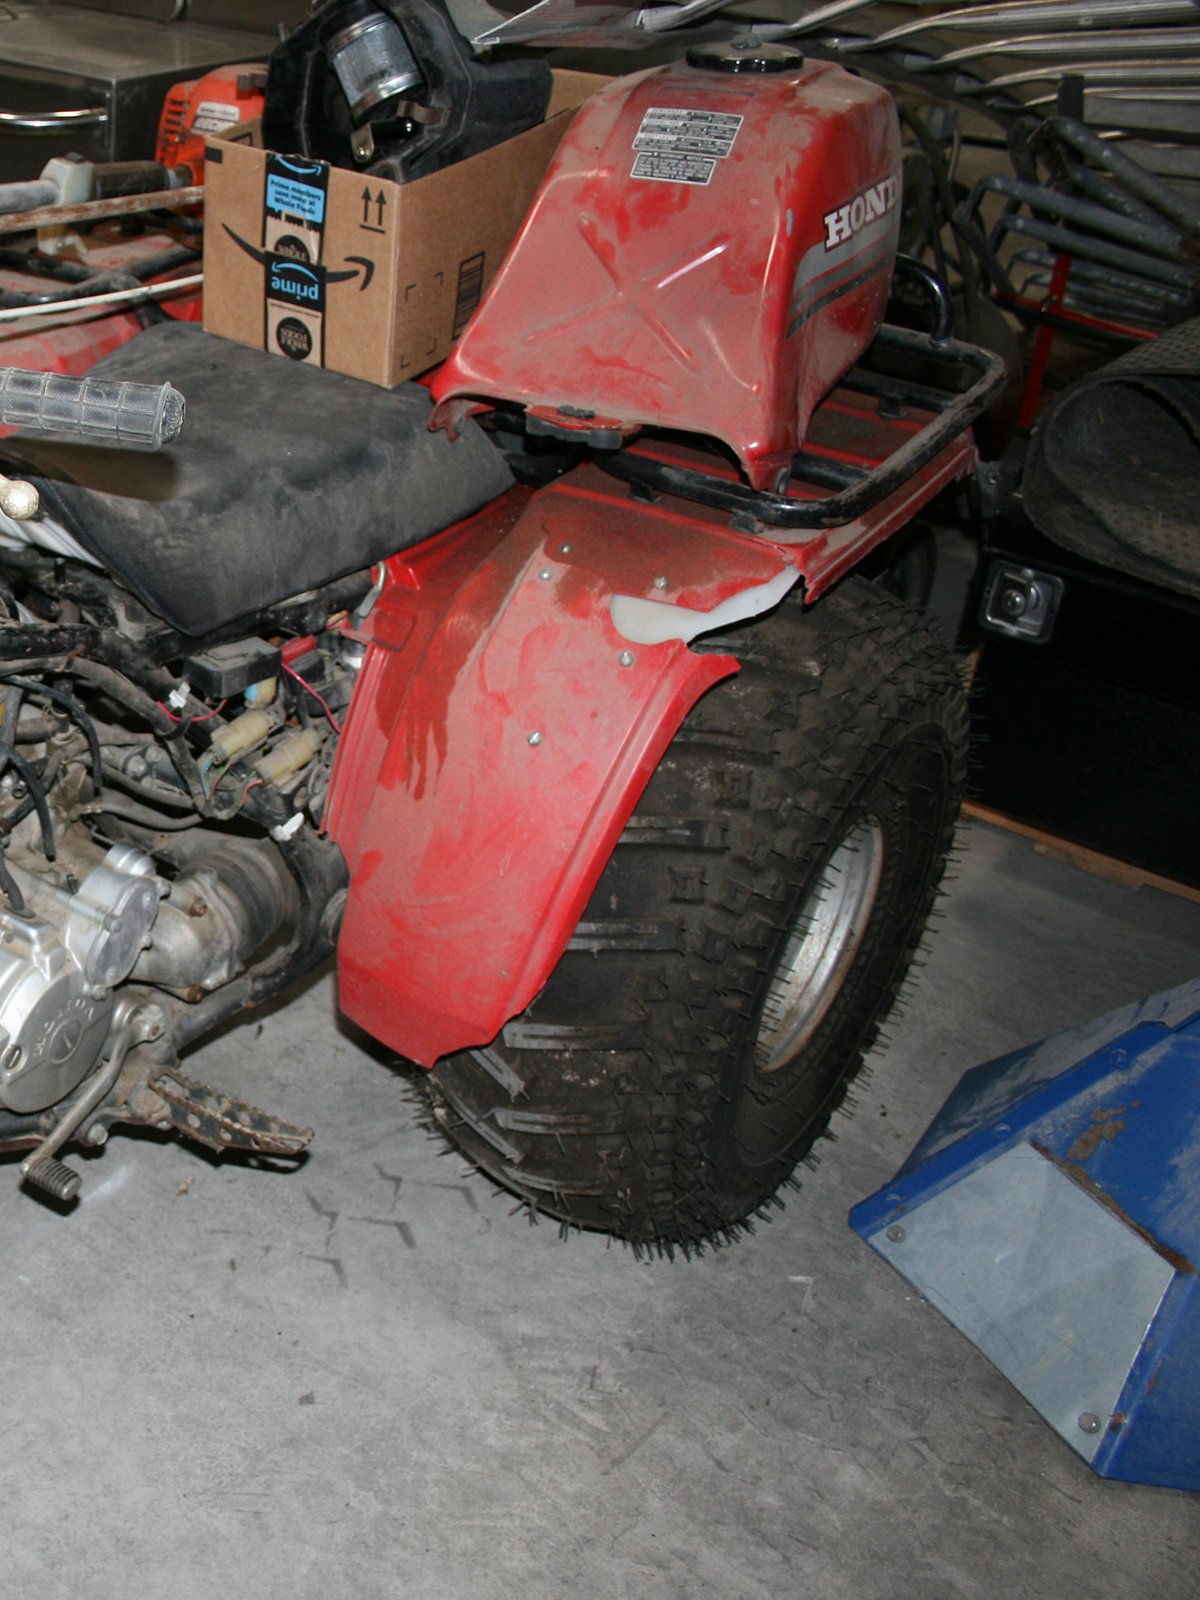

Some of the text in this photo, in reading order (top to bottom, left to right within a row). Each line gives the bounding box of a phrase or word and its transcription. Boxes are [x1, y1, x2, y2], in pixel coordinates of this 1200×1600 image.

[270, 178, 290, 191] Prime
[274, 196, 295, 208] Whole
[824, 174, 898, 249] HOND
[271, 276, 319, 300] prime
